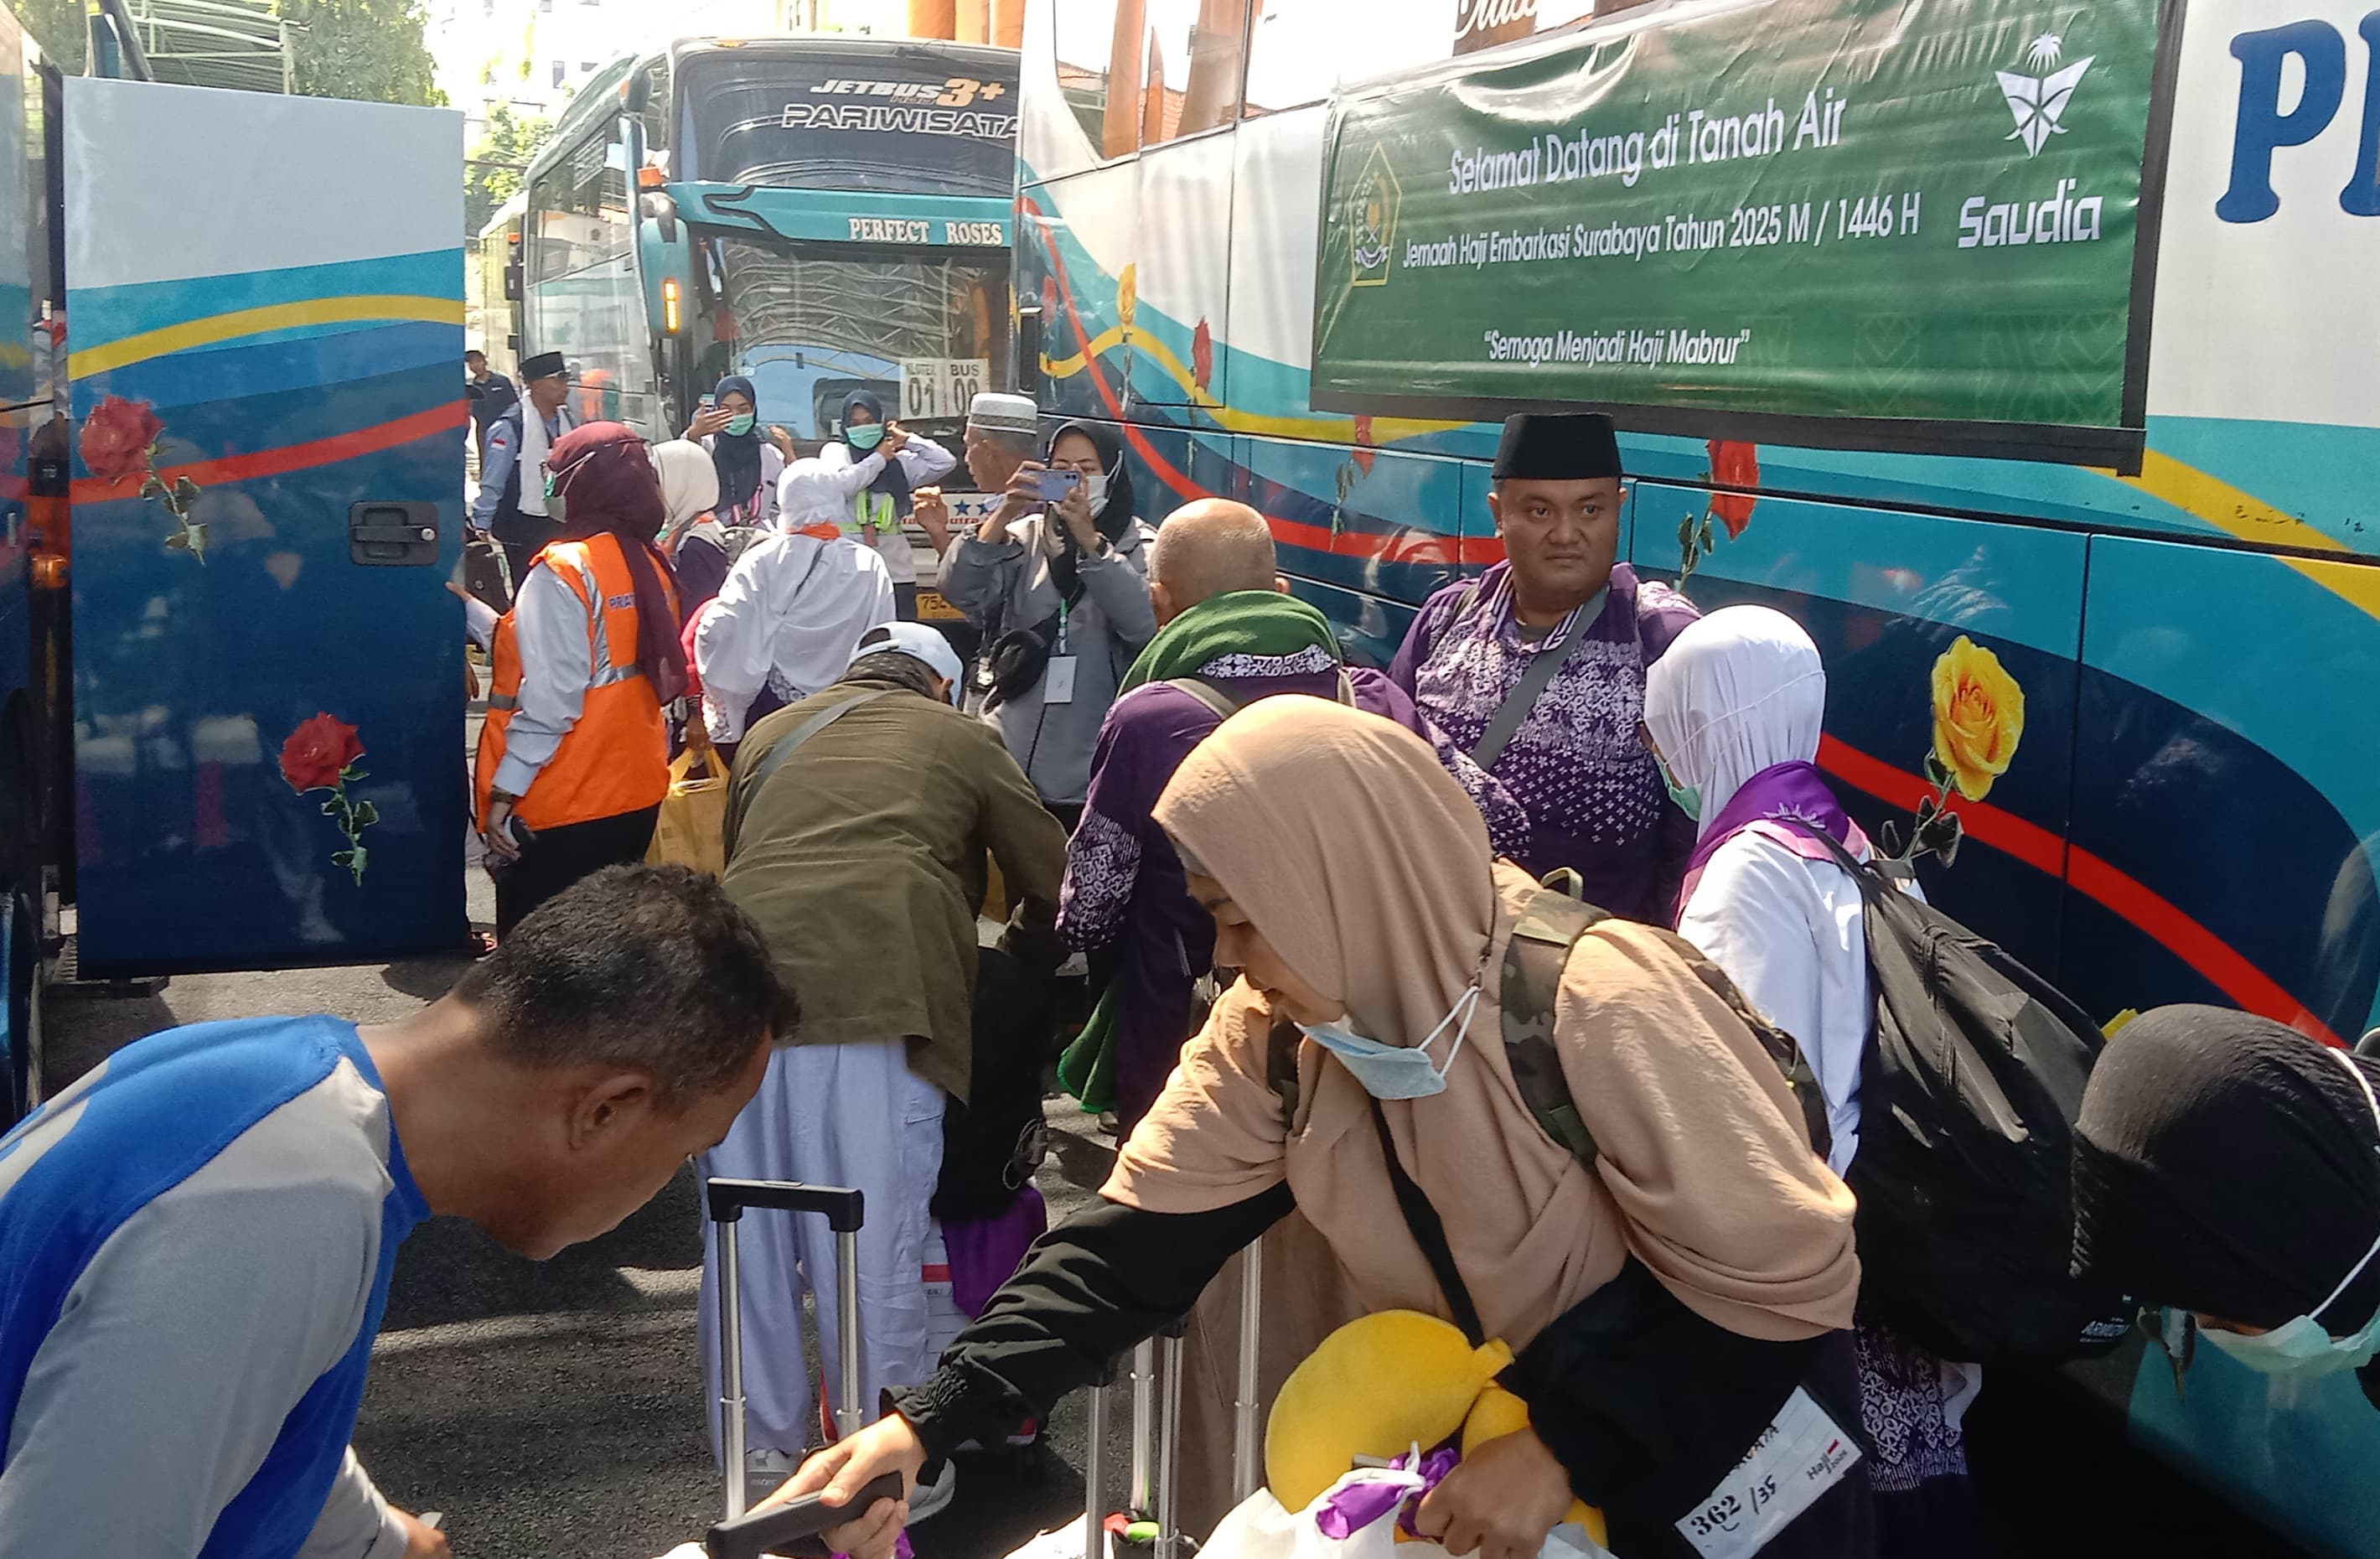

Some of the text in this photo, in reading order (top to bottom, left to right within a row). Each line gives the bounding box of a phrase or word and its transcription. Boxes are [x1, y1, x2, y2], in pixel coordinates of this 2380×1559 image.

[1448, 86, 1847, 194] Selamat Datang di Tanah Air
[848, 218, 1003, 246] PERFECT ROSES
[1402, 235, 1456, 268] Jemaah
[1460, 232, 1488, 270] Haji
[1489, 225, 1570, 262] Embarkasi
[1573, 220, 1662, 262] Surabaya
[1665, 213, 1725, 251] Tahun
[1729, 205, 1782, 246] 2025
[1787, 202, 1811, 243] M
[1813, 199, 1831, 247] /
[1838, 194, 1893, 240] 1446
[1900, 191, 1921, 236] H
[1958, 178, 2103, 248] Saudia
[950, 364, 980, 376] BUS
[1555, 329, 1626, 369] Menjadi
[1627, 329, 1665, 370] Haji
[908, 377, 935, 417] 01
[1690, 1494, 1741, 1536] 362
